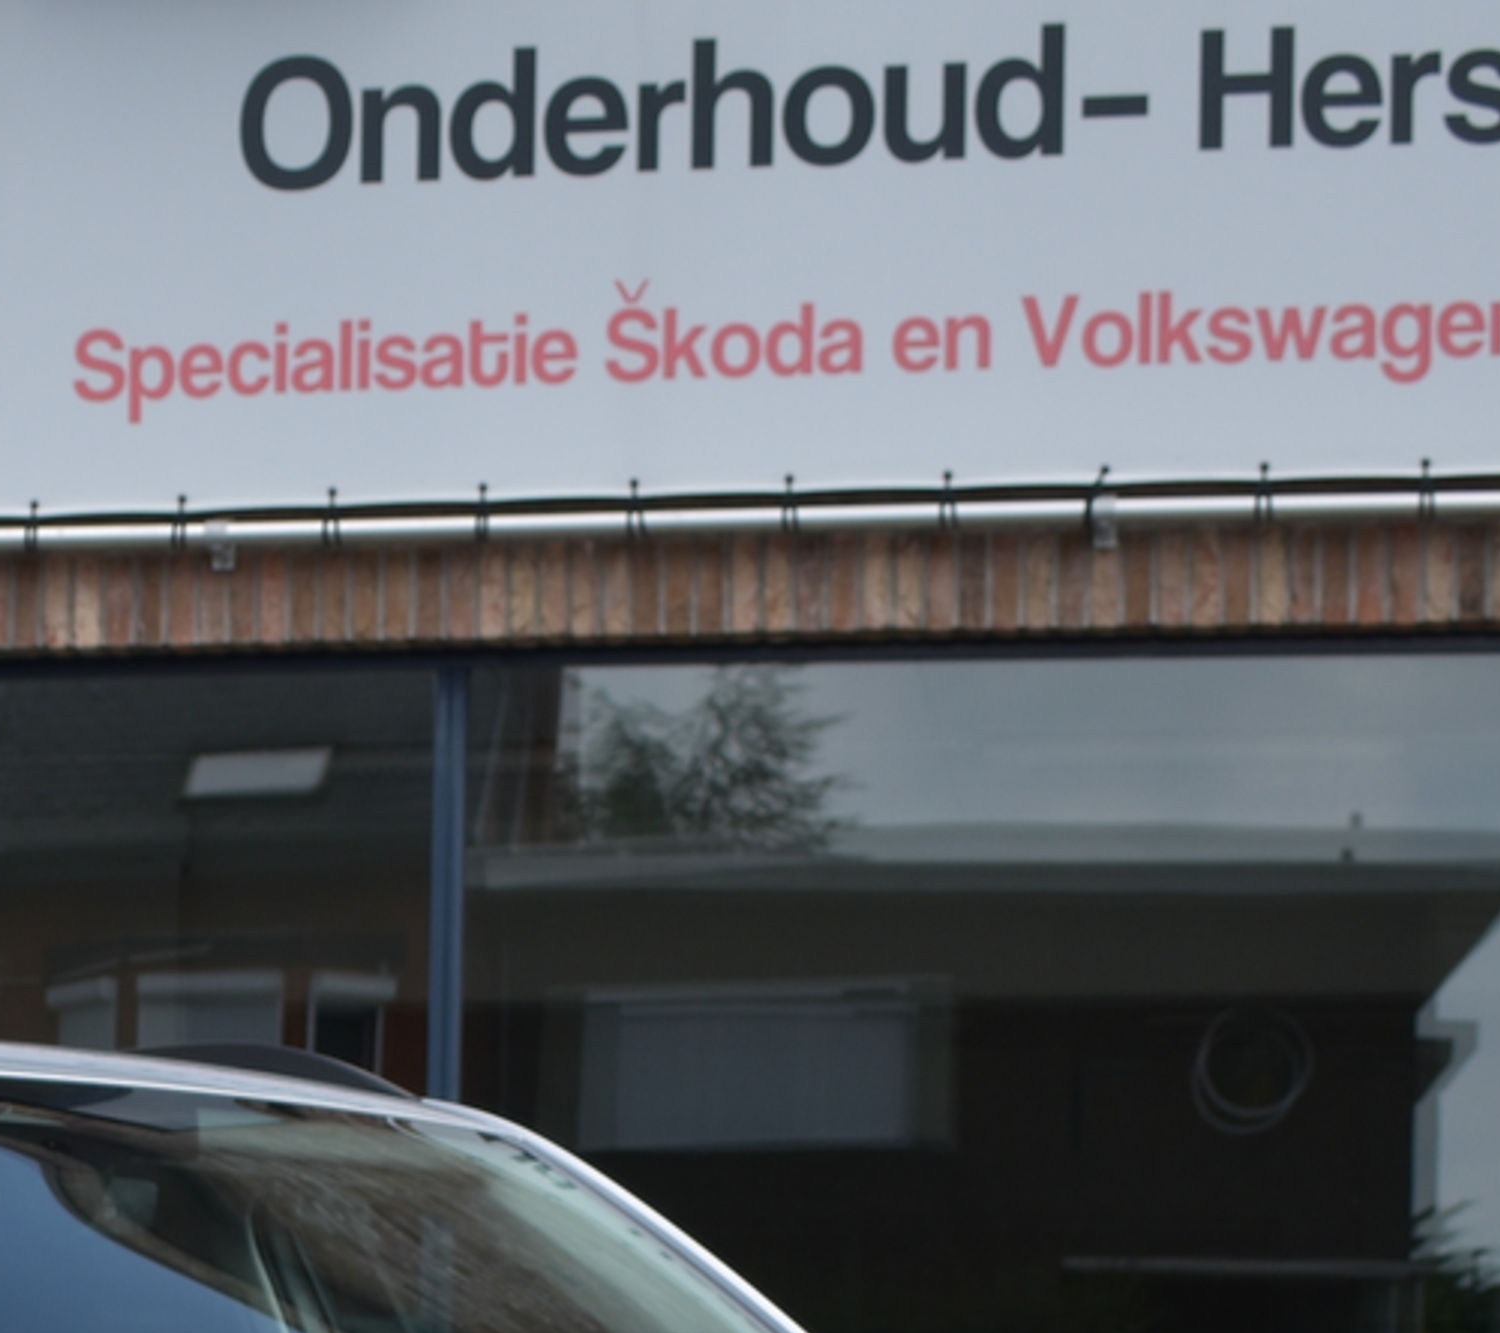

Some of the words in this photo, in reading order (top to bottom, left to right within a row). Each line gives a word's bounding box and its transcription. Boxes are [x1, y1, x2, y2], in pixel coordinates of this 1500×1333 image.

[74, 318, 580, 425] Specialisatie
[605, 283, 865, 386] Škoda
[892, 313, 993, 375] en
